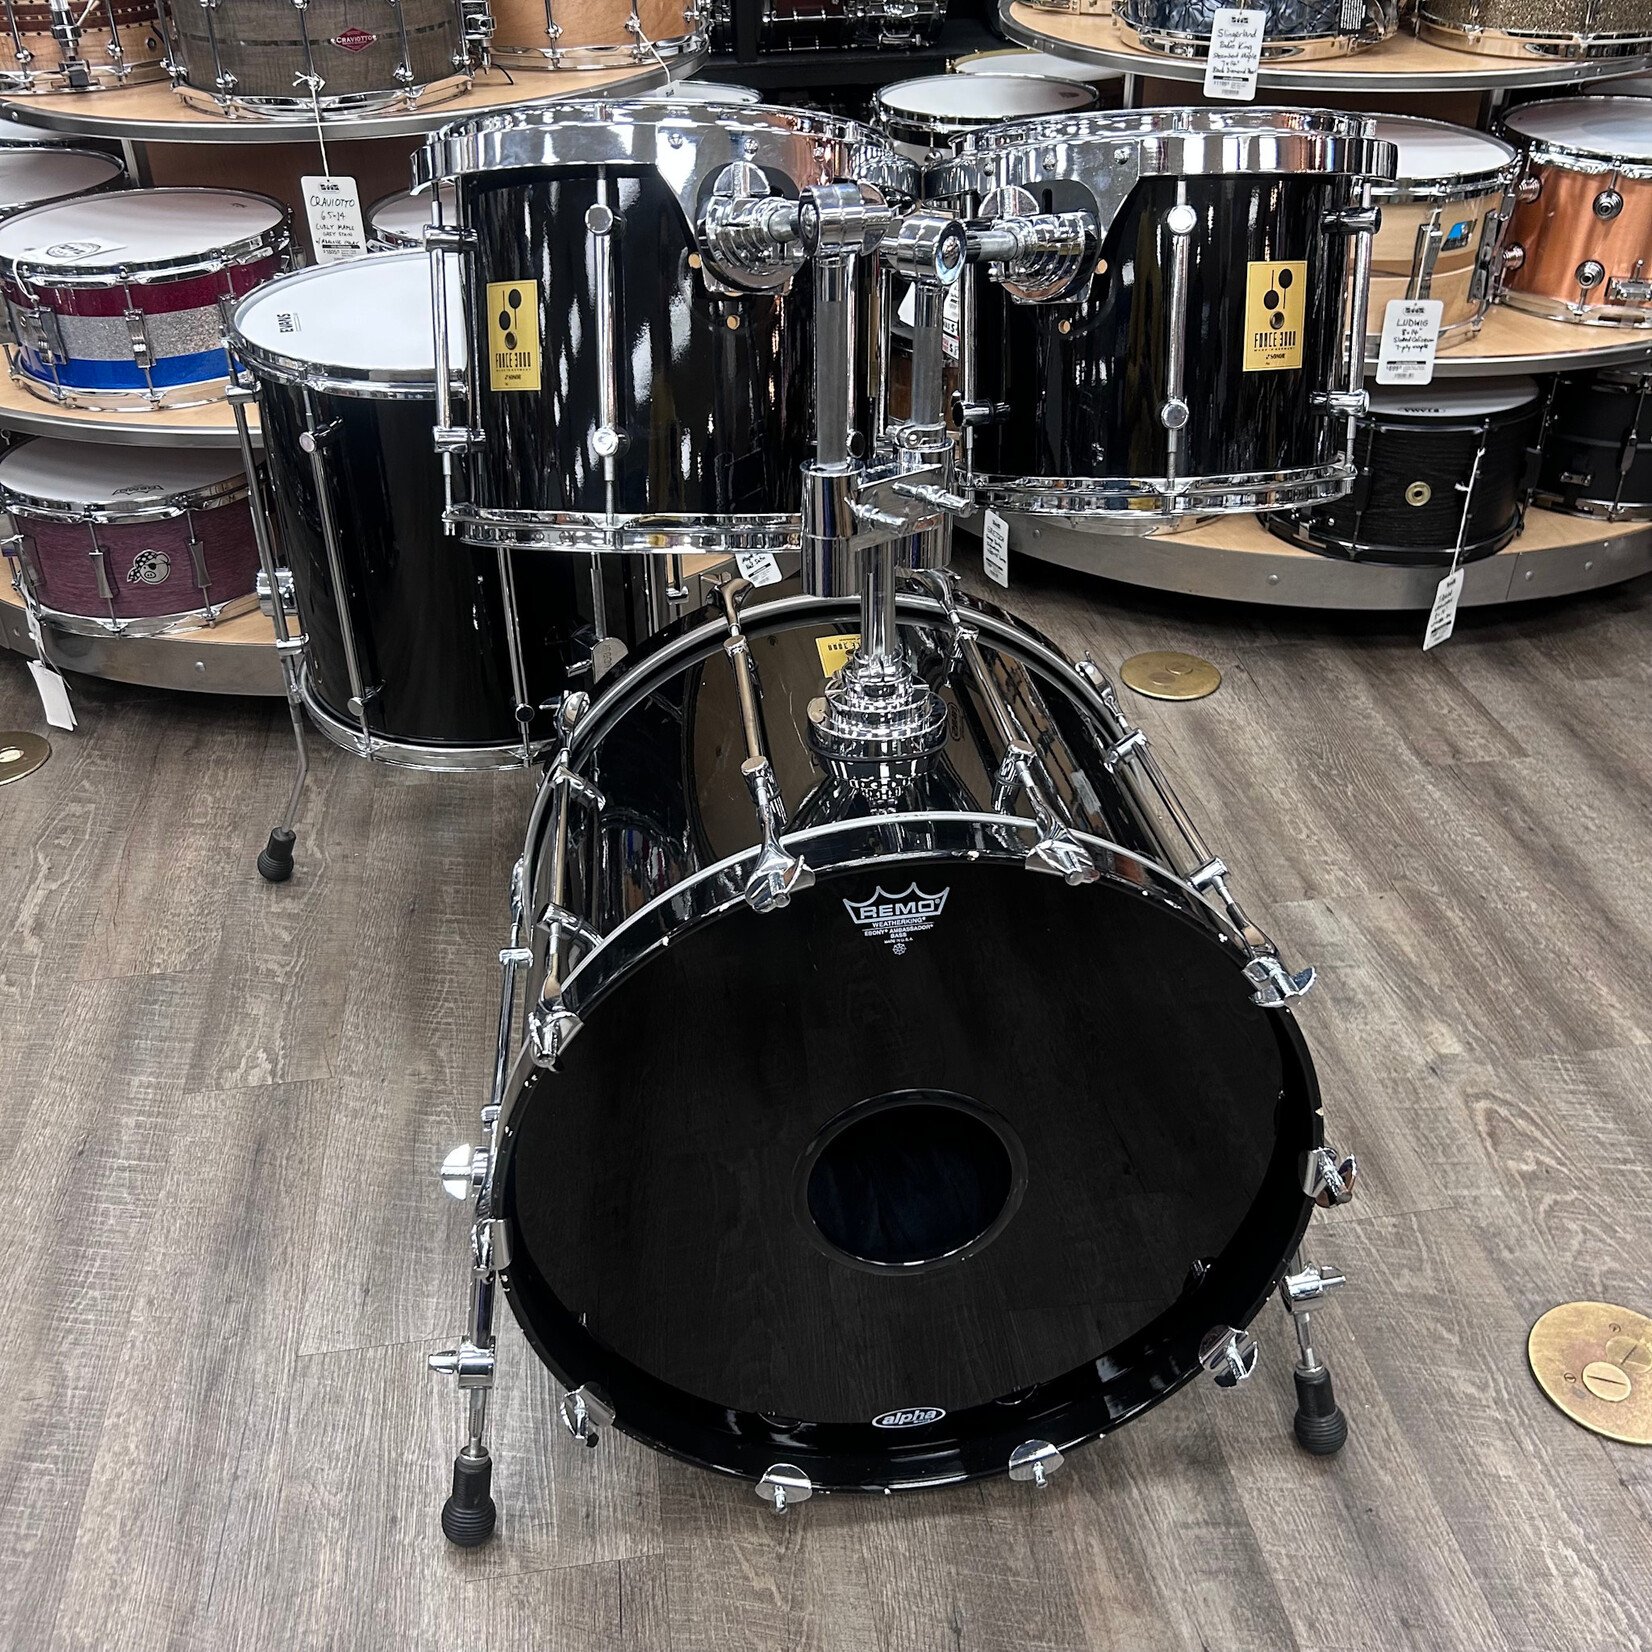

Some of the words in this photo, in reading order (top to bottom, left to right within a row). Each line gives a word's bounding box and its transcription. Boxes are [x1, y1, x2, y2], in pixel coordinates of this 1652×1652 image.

[336, 35, 373, 43] CRAVIOTTO
[1217, 28, 1257, 43] Slingerland
[1238, 41, 1252, 53] King
[310, 195, 355, 207] CRAVIOTTO
[277, 313, 294, 333] EVANS
[1396, 318, 1429, 327] LUDWIG
[1254, 332, 1277, 348] FORCE
[1280, 331, 1296, 346] 3000
[495, 353, 512, 369] FORCE
[514, 352, 531, 367] 3000
[882, 1409, 937, 1425] alpha
